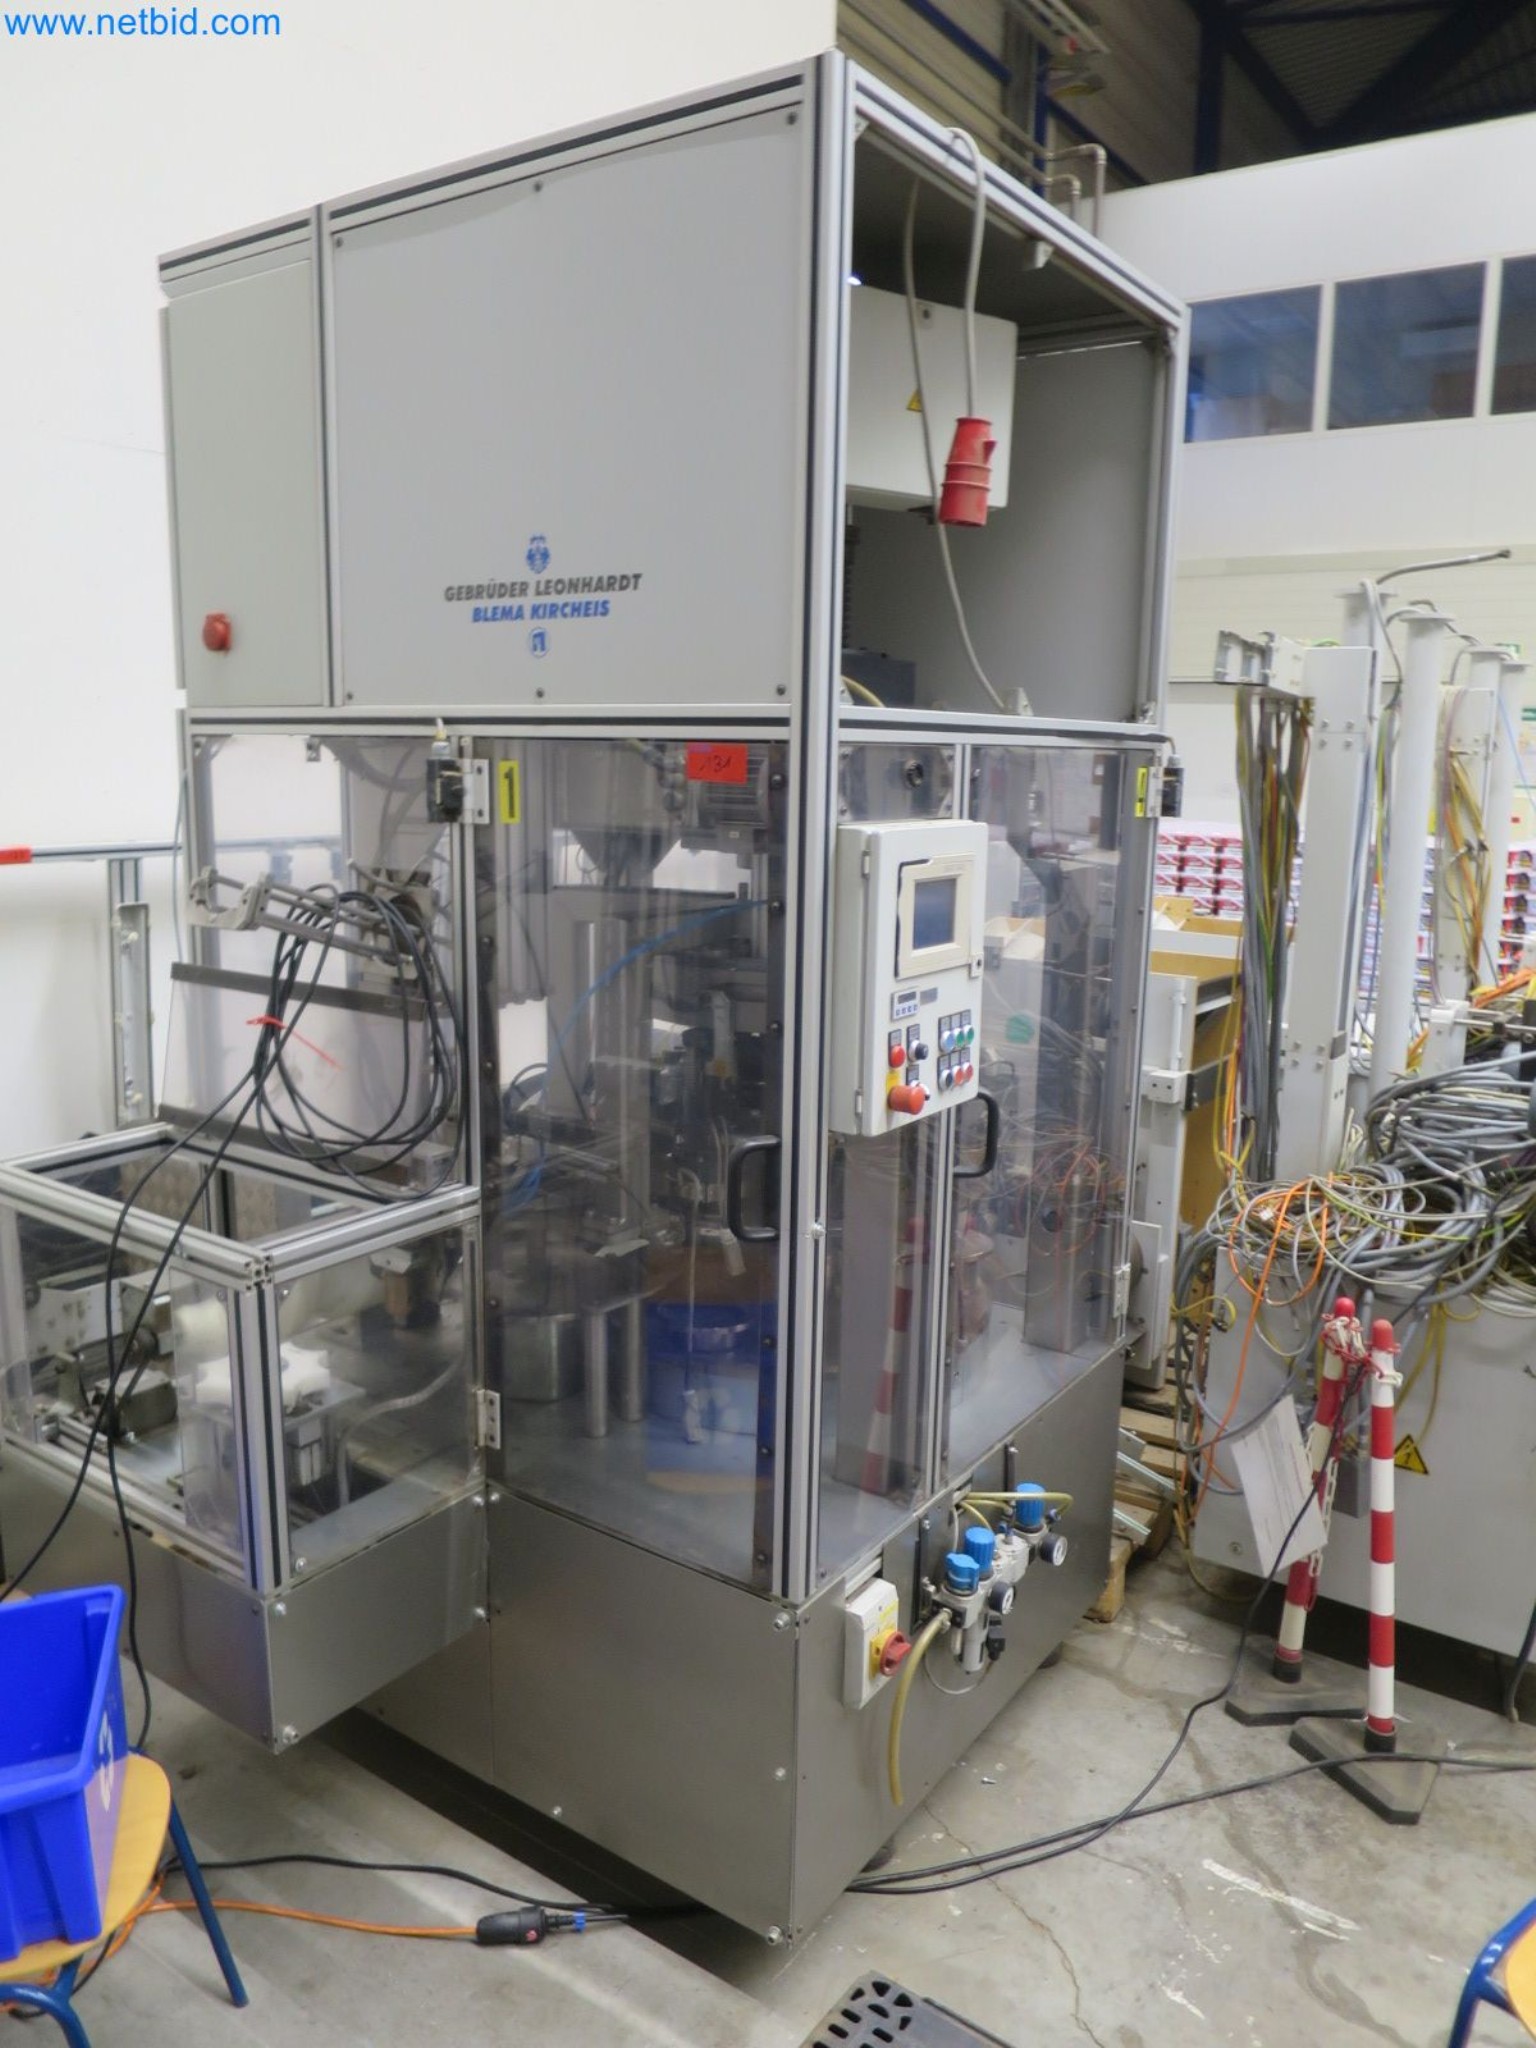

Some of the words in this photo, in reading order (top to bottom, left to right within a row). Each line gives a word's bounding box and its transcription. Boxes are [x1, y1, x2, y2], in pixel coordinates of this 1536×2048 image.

[444, 578, 529, 601] GEBRÜDER
[535, 573, 643, 597] LEONHARDT
[472, 605, 524, 623] BLEMA
[530, 600, 610, 620] KIRCHEIS
[503, 766, 516, 819] 1
